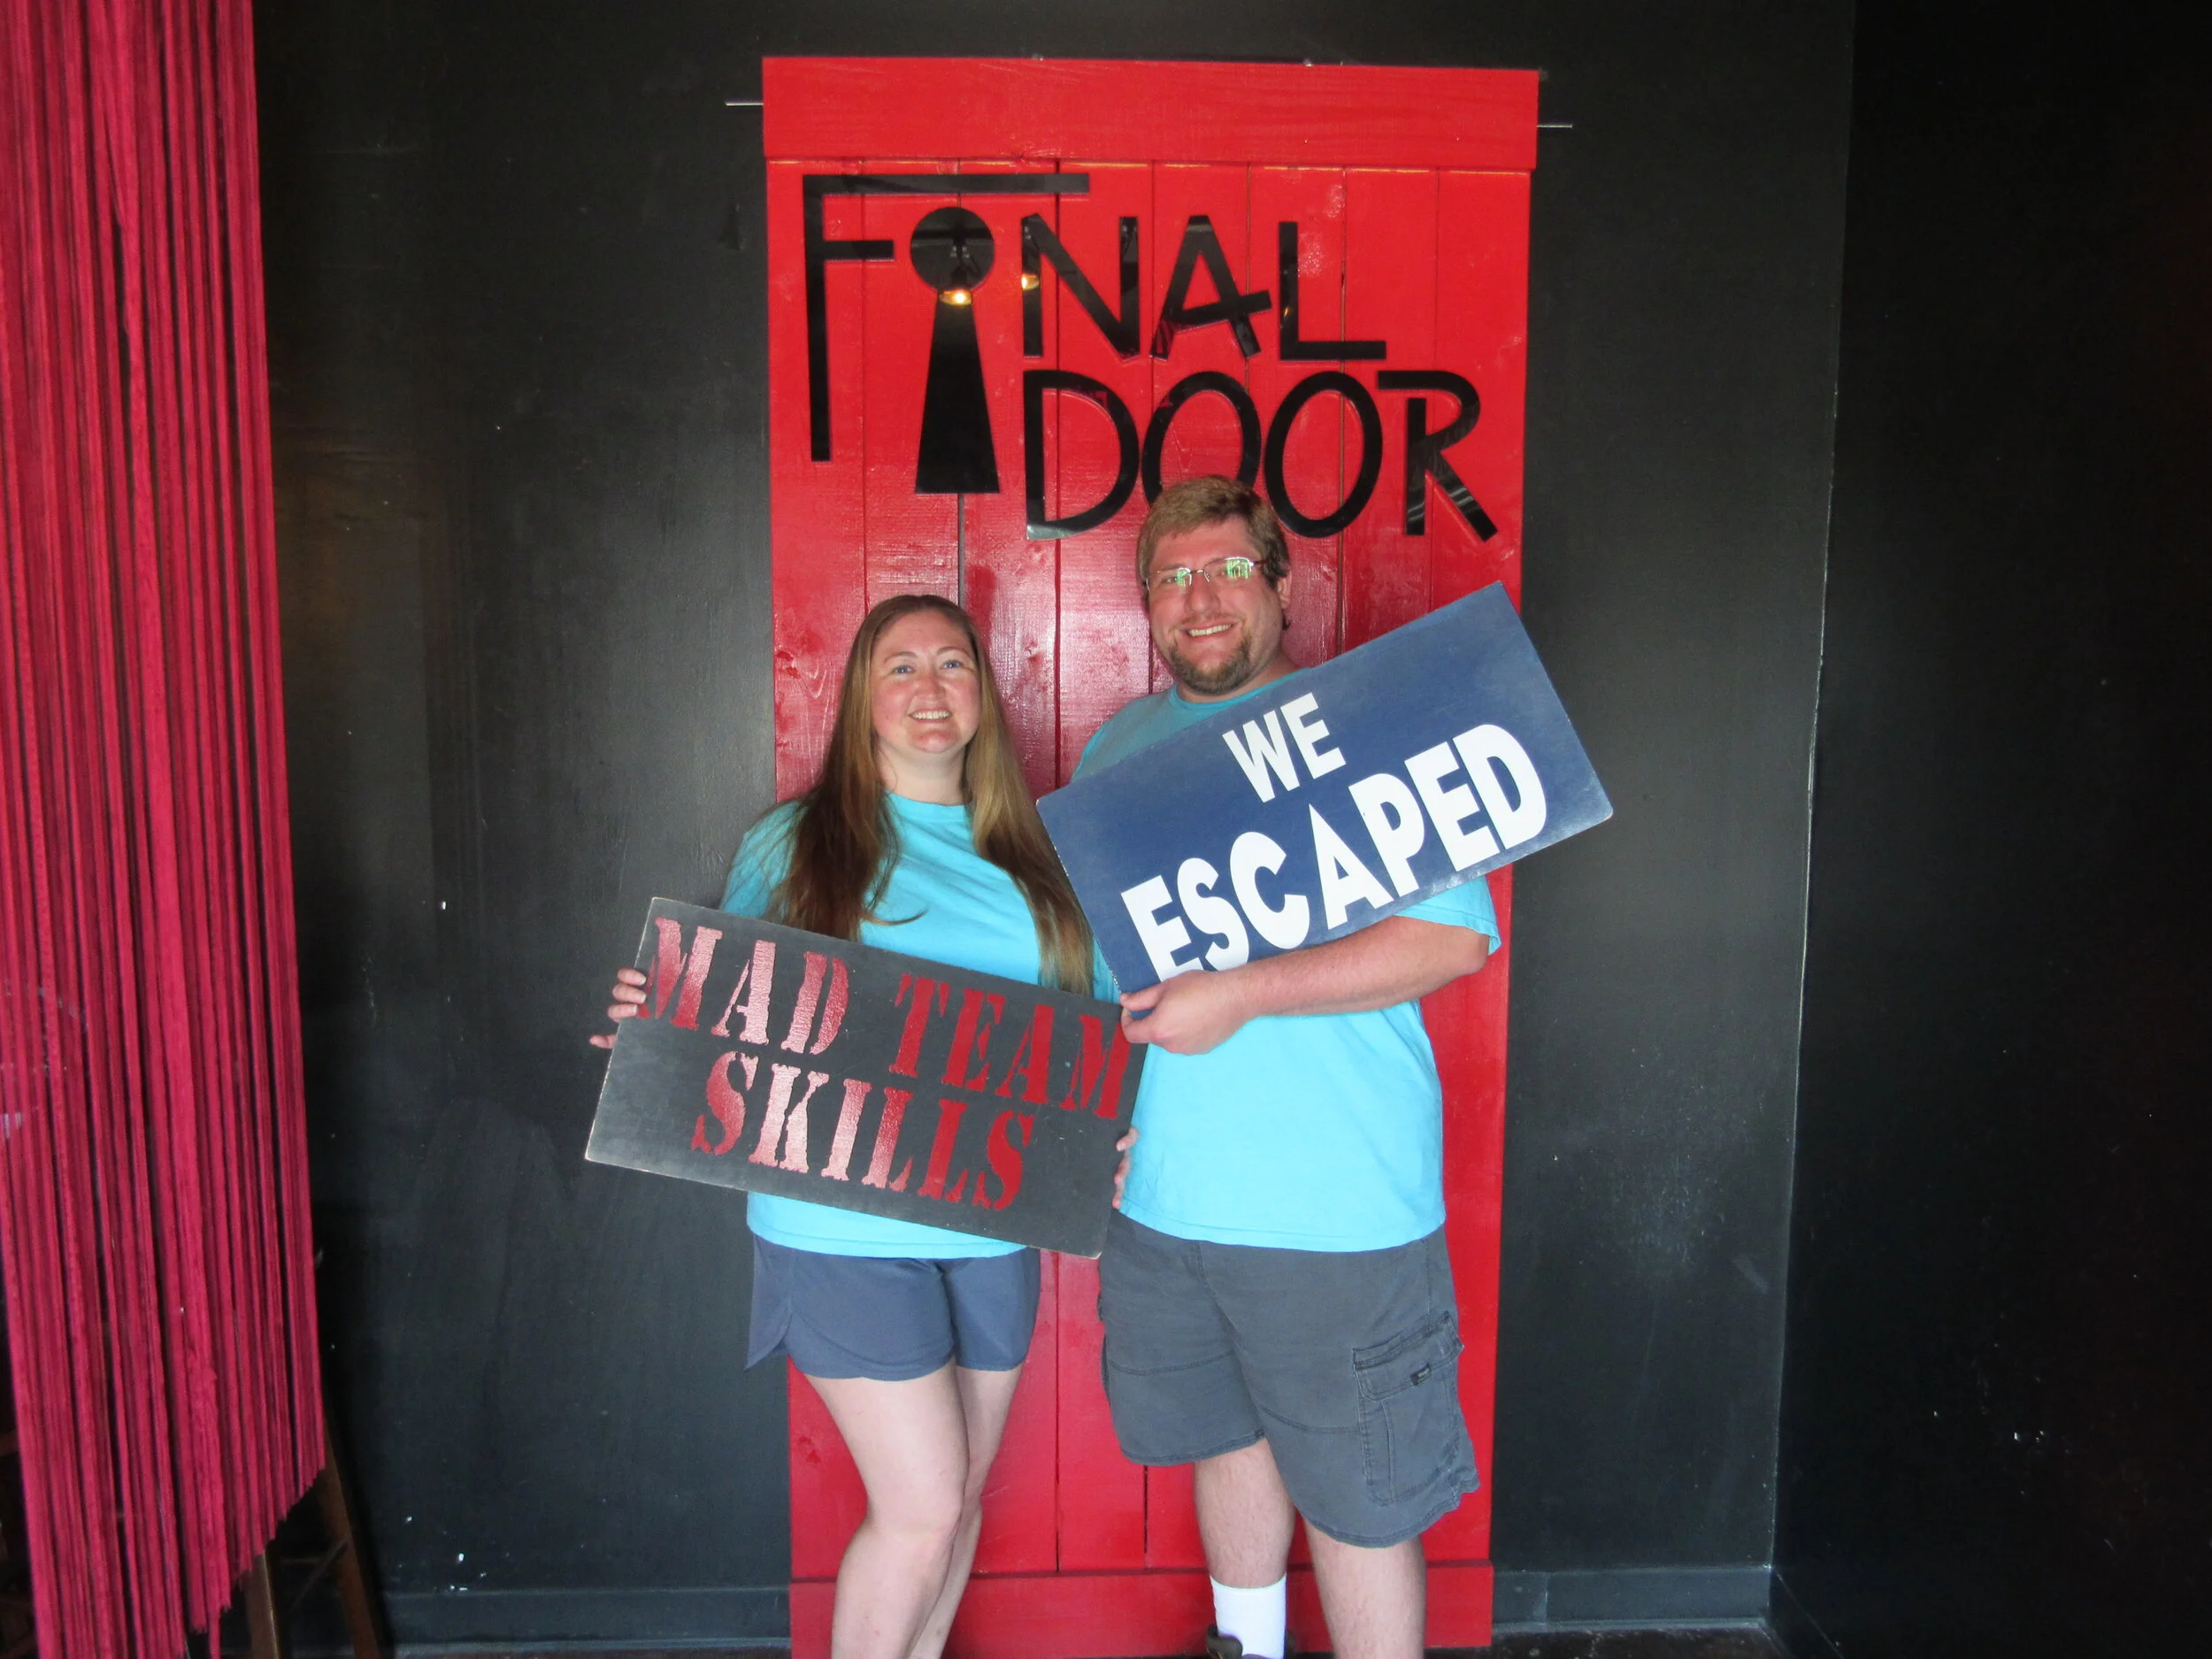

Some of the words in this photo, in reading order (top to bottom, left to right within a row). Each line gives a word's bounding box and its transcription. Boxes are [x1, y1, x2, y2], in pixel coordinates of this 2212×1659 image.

[1022, 369, 1498, 541] DOOR
[1221, 692, 1347, 803] WE
[1120, 724, 1548, 983] ESCAPED
[636, 917, 849, 1056] MAD
[888, 972, 1133, 1120] TEAM
[690, 1050, 1036, 1211] SKILLS
